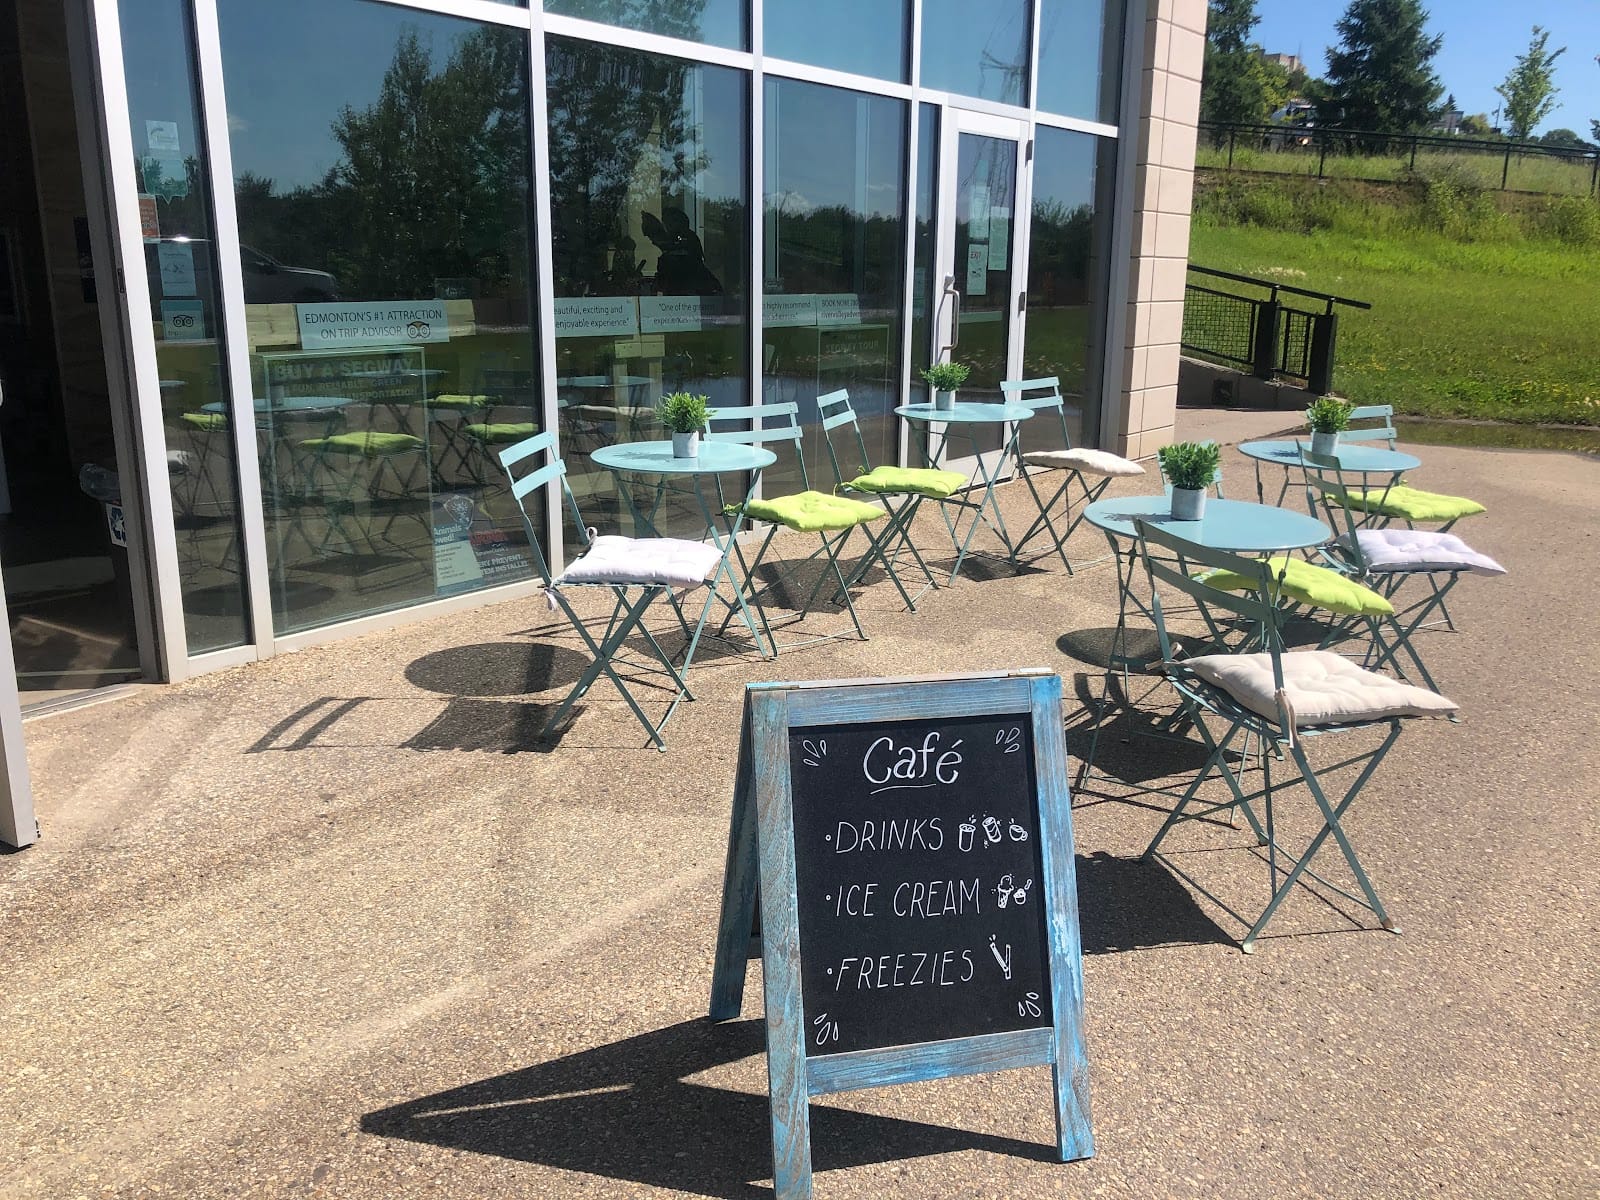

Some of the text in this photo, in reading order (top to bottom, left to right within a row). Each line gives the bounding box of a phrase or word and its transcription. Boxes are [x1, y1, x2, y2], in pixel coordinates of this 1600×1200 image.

[305, 308, 442, 324] EDMONTON'S #1 ATTRACTION
[554, 304, 623, 316] eautiful, exciting and
[320, 326, 402, 339] ON TRIP ADVISOR
[555, 318, 590, 329] enjoyable
[341, 358, 414, 376] SEGWAY
[863, 731, 963, 785] Café
[835, 817, 944, 854] DRINKS
[836, 878, 981, 919] ICE CREAM
[835, 949, 974, 991] FREEZIES
